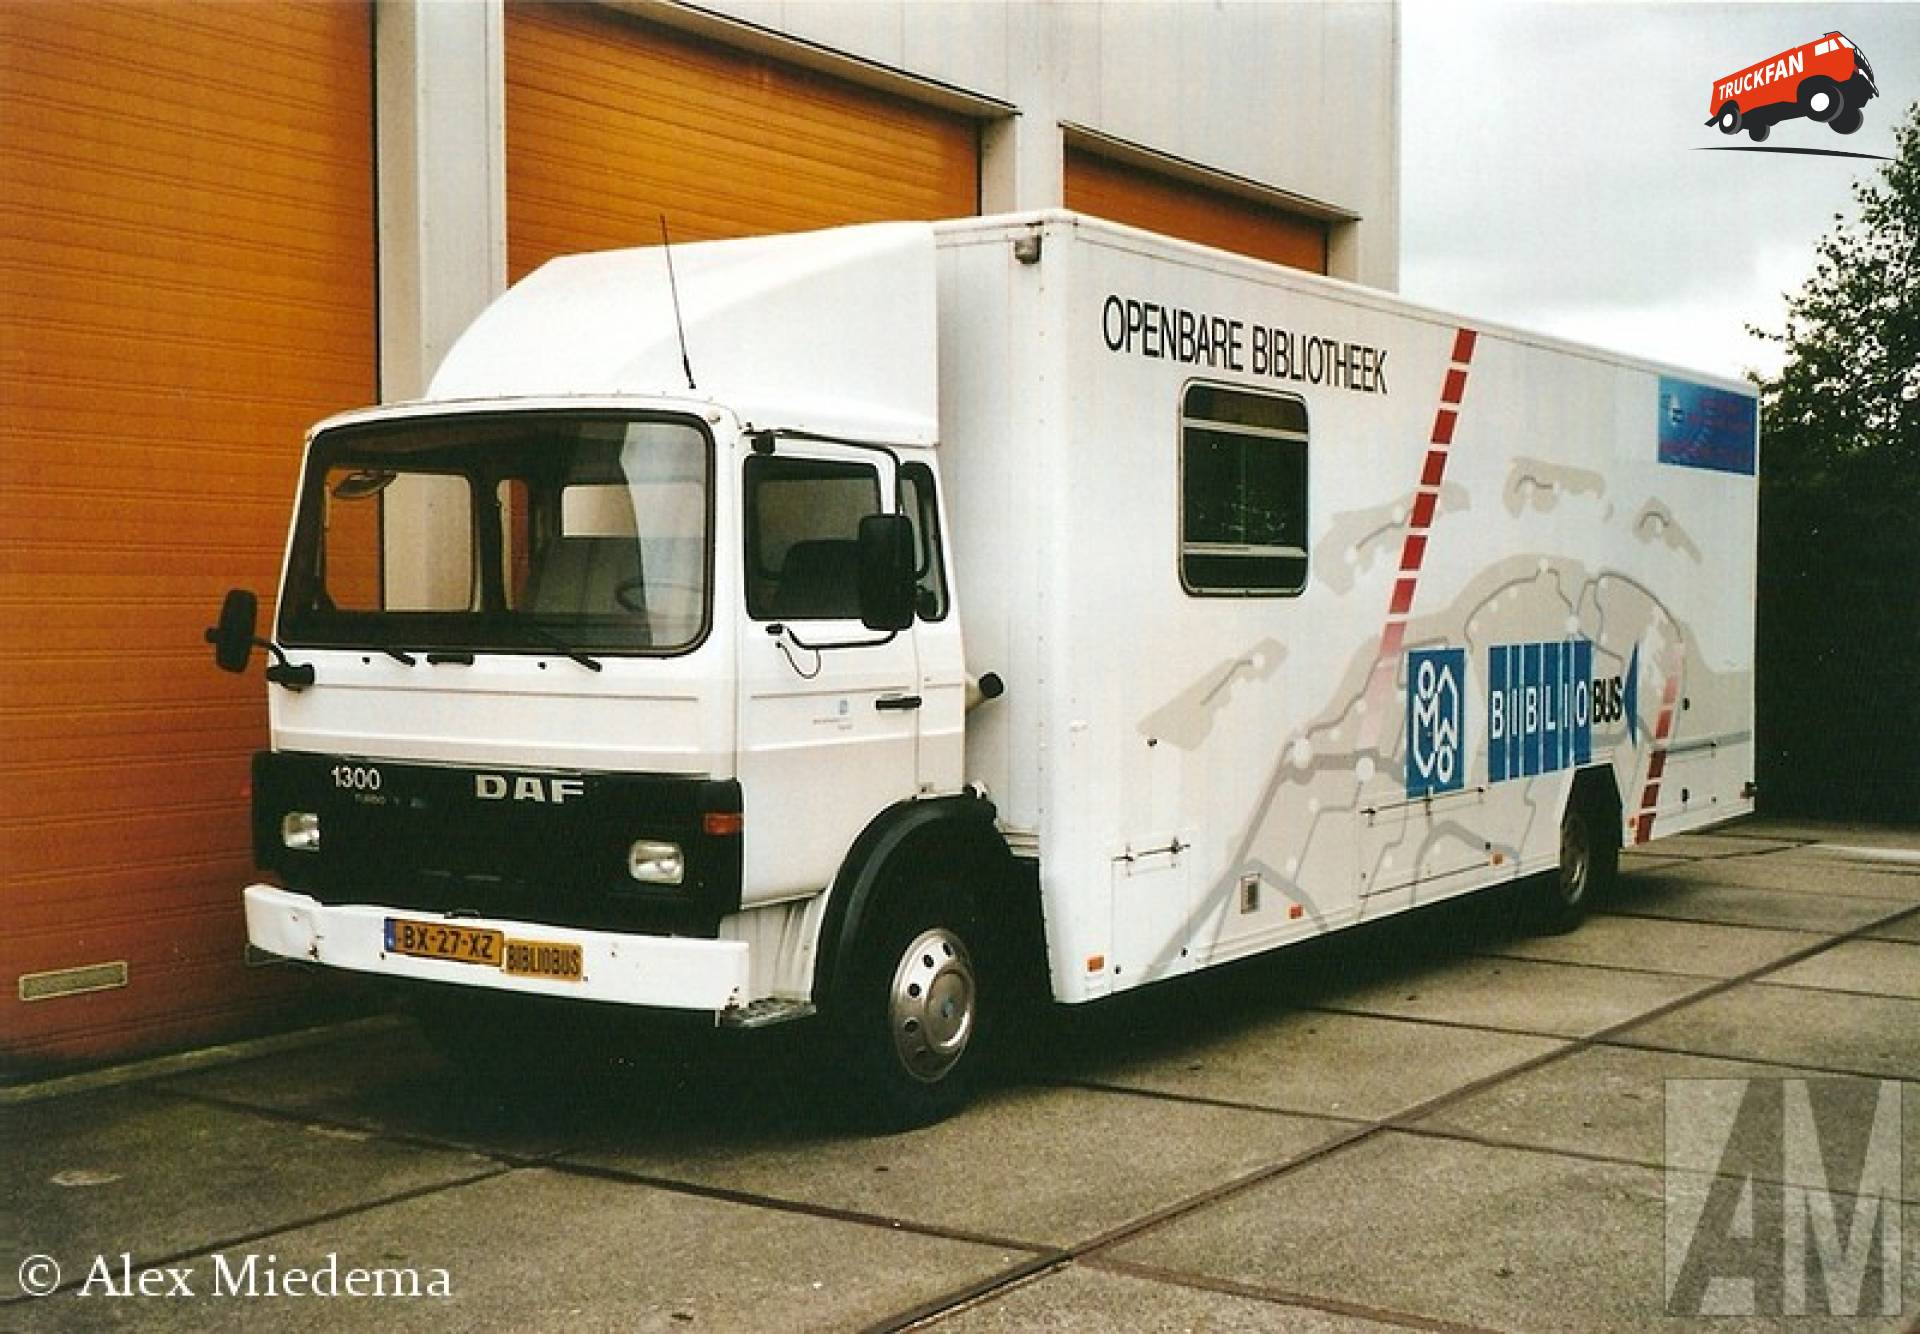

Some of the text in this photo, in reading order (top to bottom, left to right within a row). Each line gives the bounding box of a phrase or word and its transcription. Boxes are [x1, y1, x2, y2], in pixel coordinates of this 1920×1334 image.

[1103, 294, 1387, 394] OPENBARE BIBLIOTHEEK
[331, 765, 382, 790] 1300
[474, 774, 584, 804] DAF
[403, 924, 493, 959] BX-27-XZ
